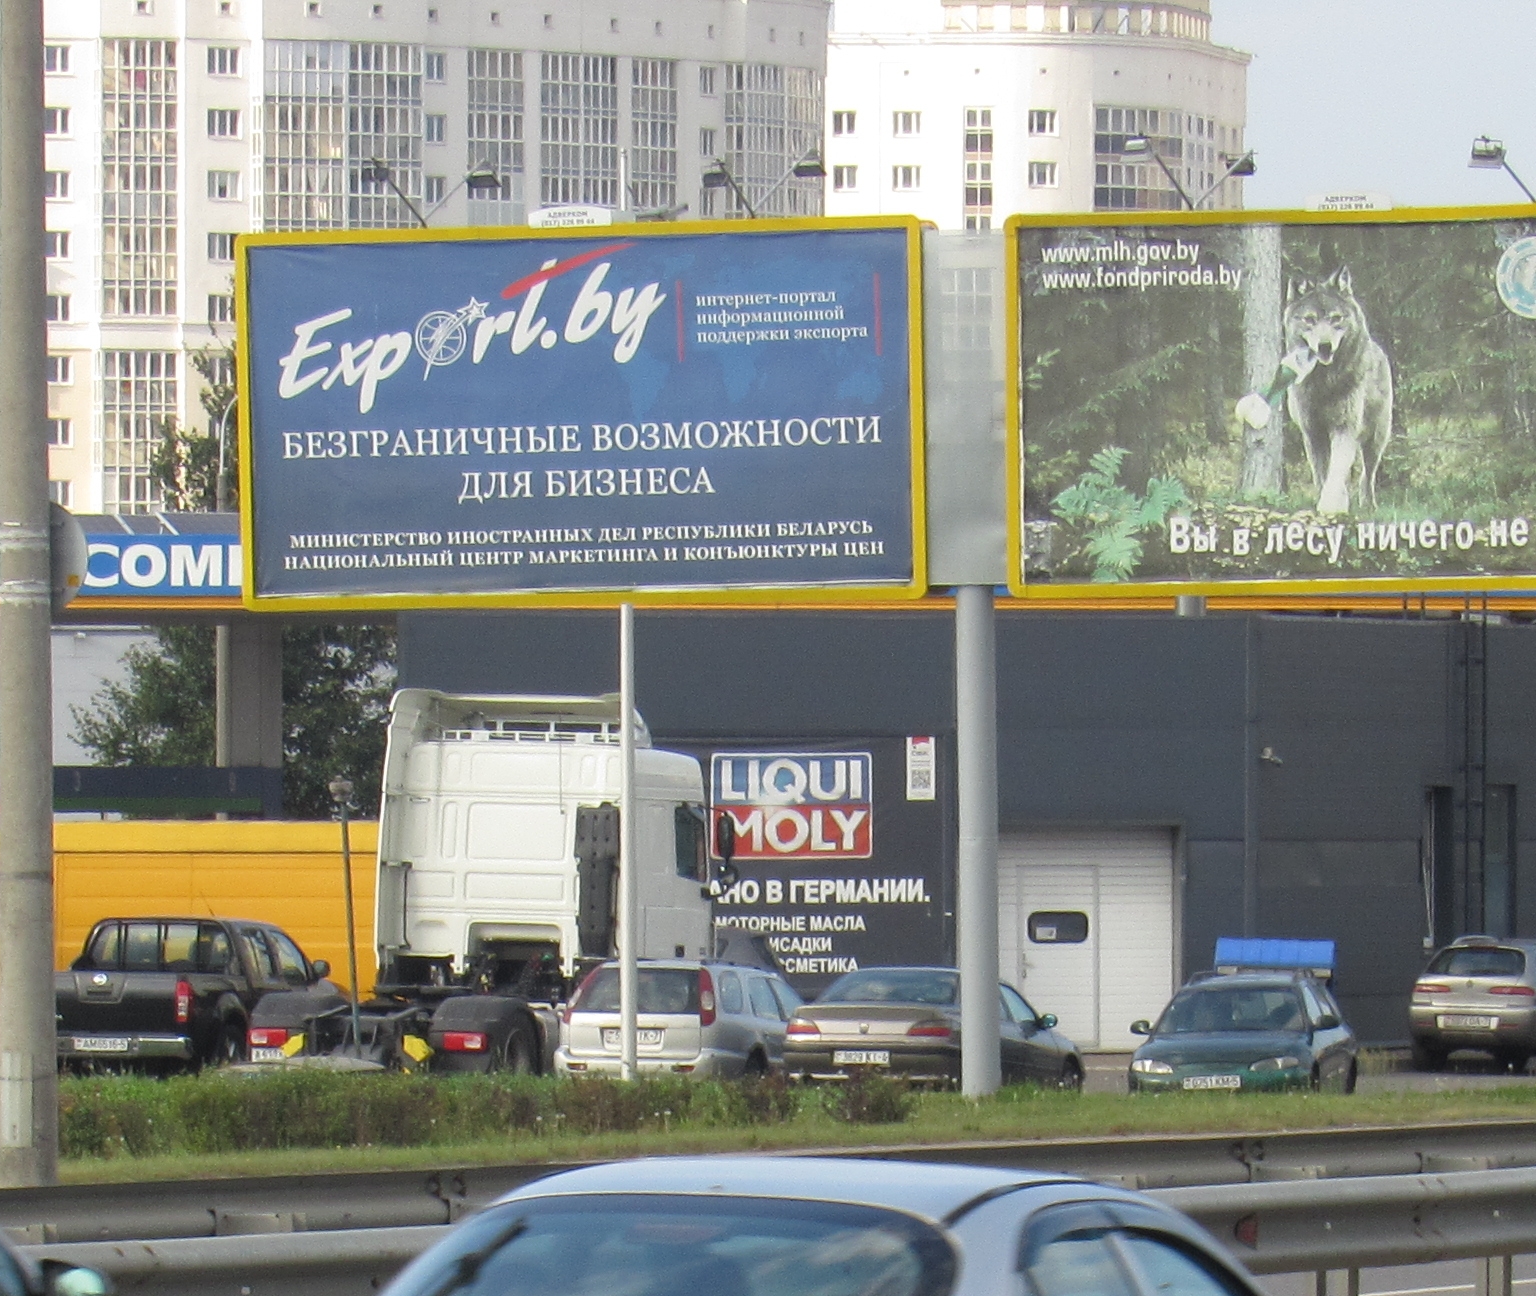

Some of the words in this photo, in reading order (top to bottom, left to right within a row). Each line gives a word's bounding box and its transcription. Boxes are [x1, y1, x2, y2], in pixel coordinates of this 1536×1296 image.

[1041, 239, 1200, 266] www.mlh.gov.by
[1042, 264, 1242, 292] www.fondpriroda.by
[695, 291, 837, 308] интернет-портал
[696, 306, 845, 327] информационной
[697, 329, 790, 345] поддержки
[793, 326, 868, 342] экспорта
[282, 425, 582, 460] БЕЗГРАНИЧНЫЕ
[592, 416, 882, 452] ВОЗМОЖНОСТИ
[458, 470, 534, 504] ДЛЯ
[545, 466, 716, 498] БИЗНЕСА
[290, 530, 442, 549] МИНИСТЕРСТВО
[447, 528, 593, 546] ИНОСТРАННЫХ
[598, 526, 637, 544] ДЕЛ
[642, 523, 771, 542] РЕСПУБЛИКИ
[776, 520, 874, 537] БЕЛАРУСЬ
[1168, 516, 1217, 554] Вы
[1232, 527, 1251, 555] в
[1264, 520, 1344, 563] лесу
[1357, 516, 1474, 551] ничего
[1488, 516, 1530, 547] не
[85, 542, 242, 588] COM
[284, 550, 454, 571] НАЦИОНАЛЬНЫЙ
[459, 549, 524, 568] ЦЕНТР
[528, 545, 659, 565] МАРКЕТИНГА
[663, 547, 678, 562] И
[684, 543, 838, 562] КОНЪЮНКТУРЫ
[843, 541, 885, 558] ЦЕН
[721, 758, 863, 803] LIQUI
[724, 808, 868, 853] MOLY
[710, 879, 760, 905] АНО
[765, 879, 784, 904] В
[789, 878, 931, 904] ГЕРМАНИИ.
[715, 915, 807, 932] МОТОРНЫЕ
[809, 915, 866, 932] МАСЛА
[768, 936, 833, 955] ИСАДКИ
[779, 957, 859, 974] СМЕТИКА
